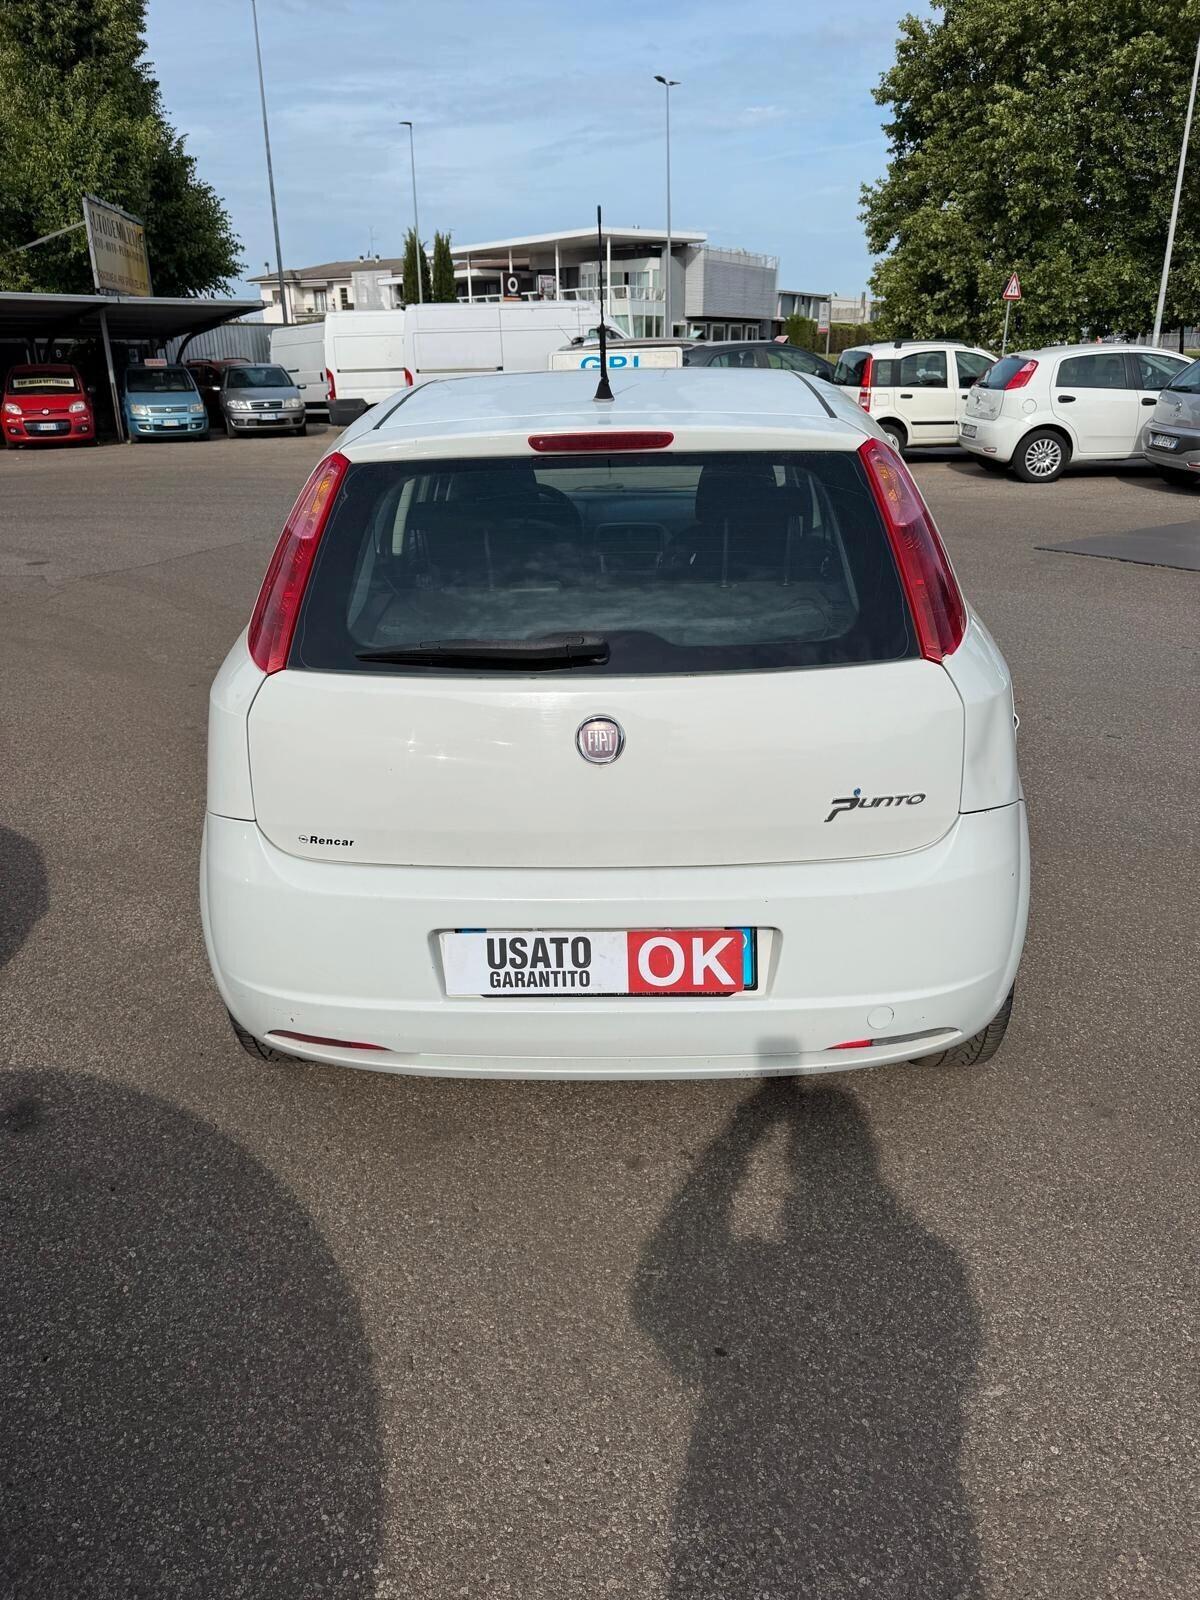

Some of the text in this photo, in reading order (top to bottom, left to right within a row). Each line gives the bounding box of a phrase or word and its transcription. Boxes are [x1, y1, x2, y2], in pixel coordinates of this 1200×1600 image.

[587, 729, 615, 751] FIAT
[309, 835, 355, 847] Rencar
[486, 935, 592, 970] USATO
[637, 935, 736, 987] OK
[489, 970, 591, 989] GARANTITO
